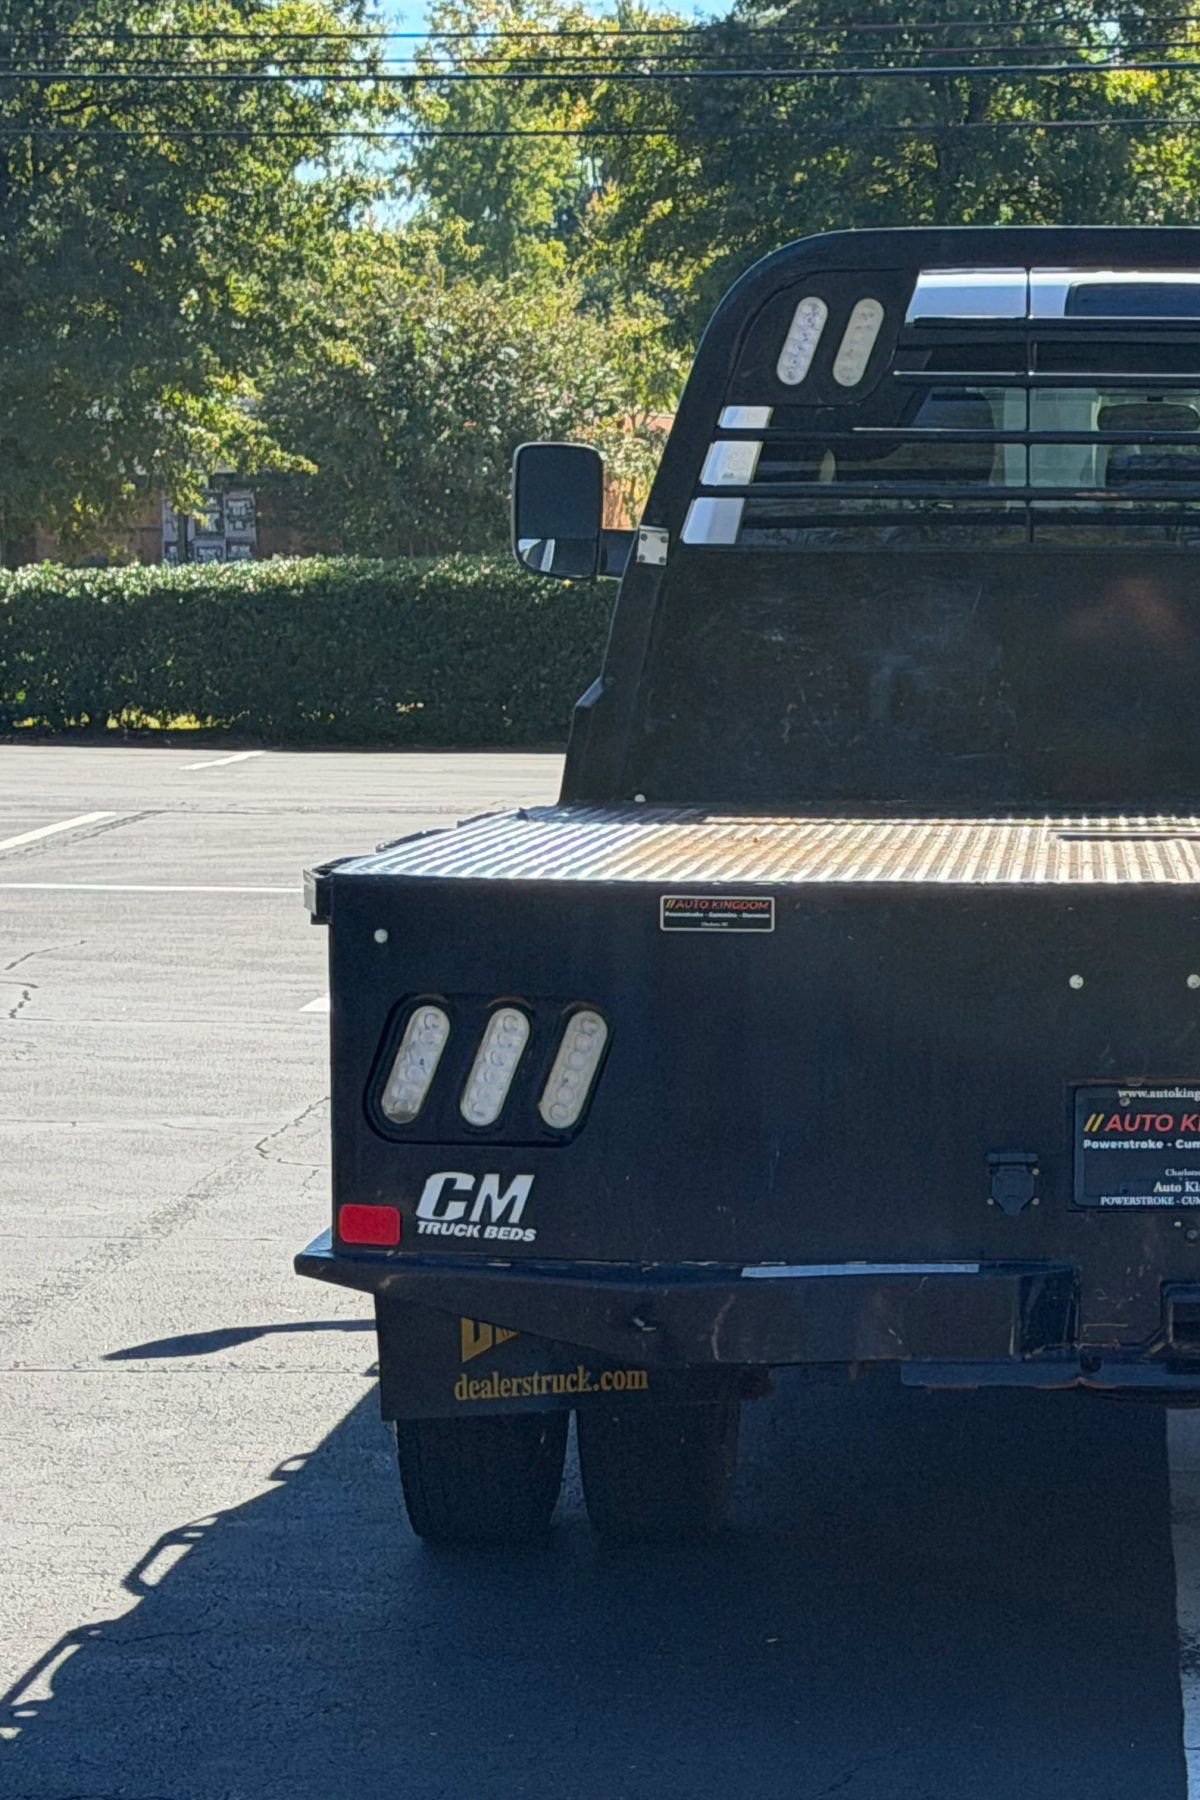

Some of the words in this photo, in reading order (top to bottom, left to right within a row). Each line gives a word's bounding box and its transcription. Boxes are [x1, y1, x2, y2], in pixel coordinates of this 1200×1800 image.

[1083, 1139, 1164, 1149] Powerstroke
[1153, 1181, 1182, 1193] Auto
[415, 1171, 535, 1223] CM
[1100, 1196, 1175, 1206] POWERSTROKE
[416, 1220, 482, 1239] TRUCK
[483, 1225, 537, 1242] BEDS
[453, 1364, 649, 1401] dealerstruck.com
